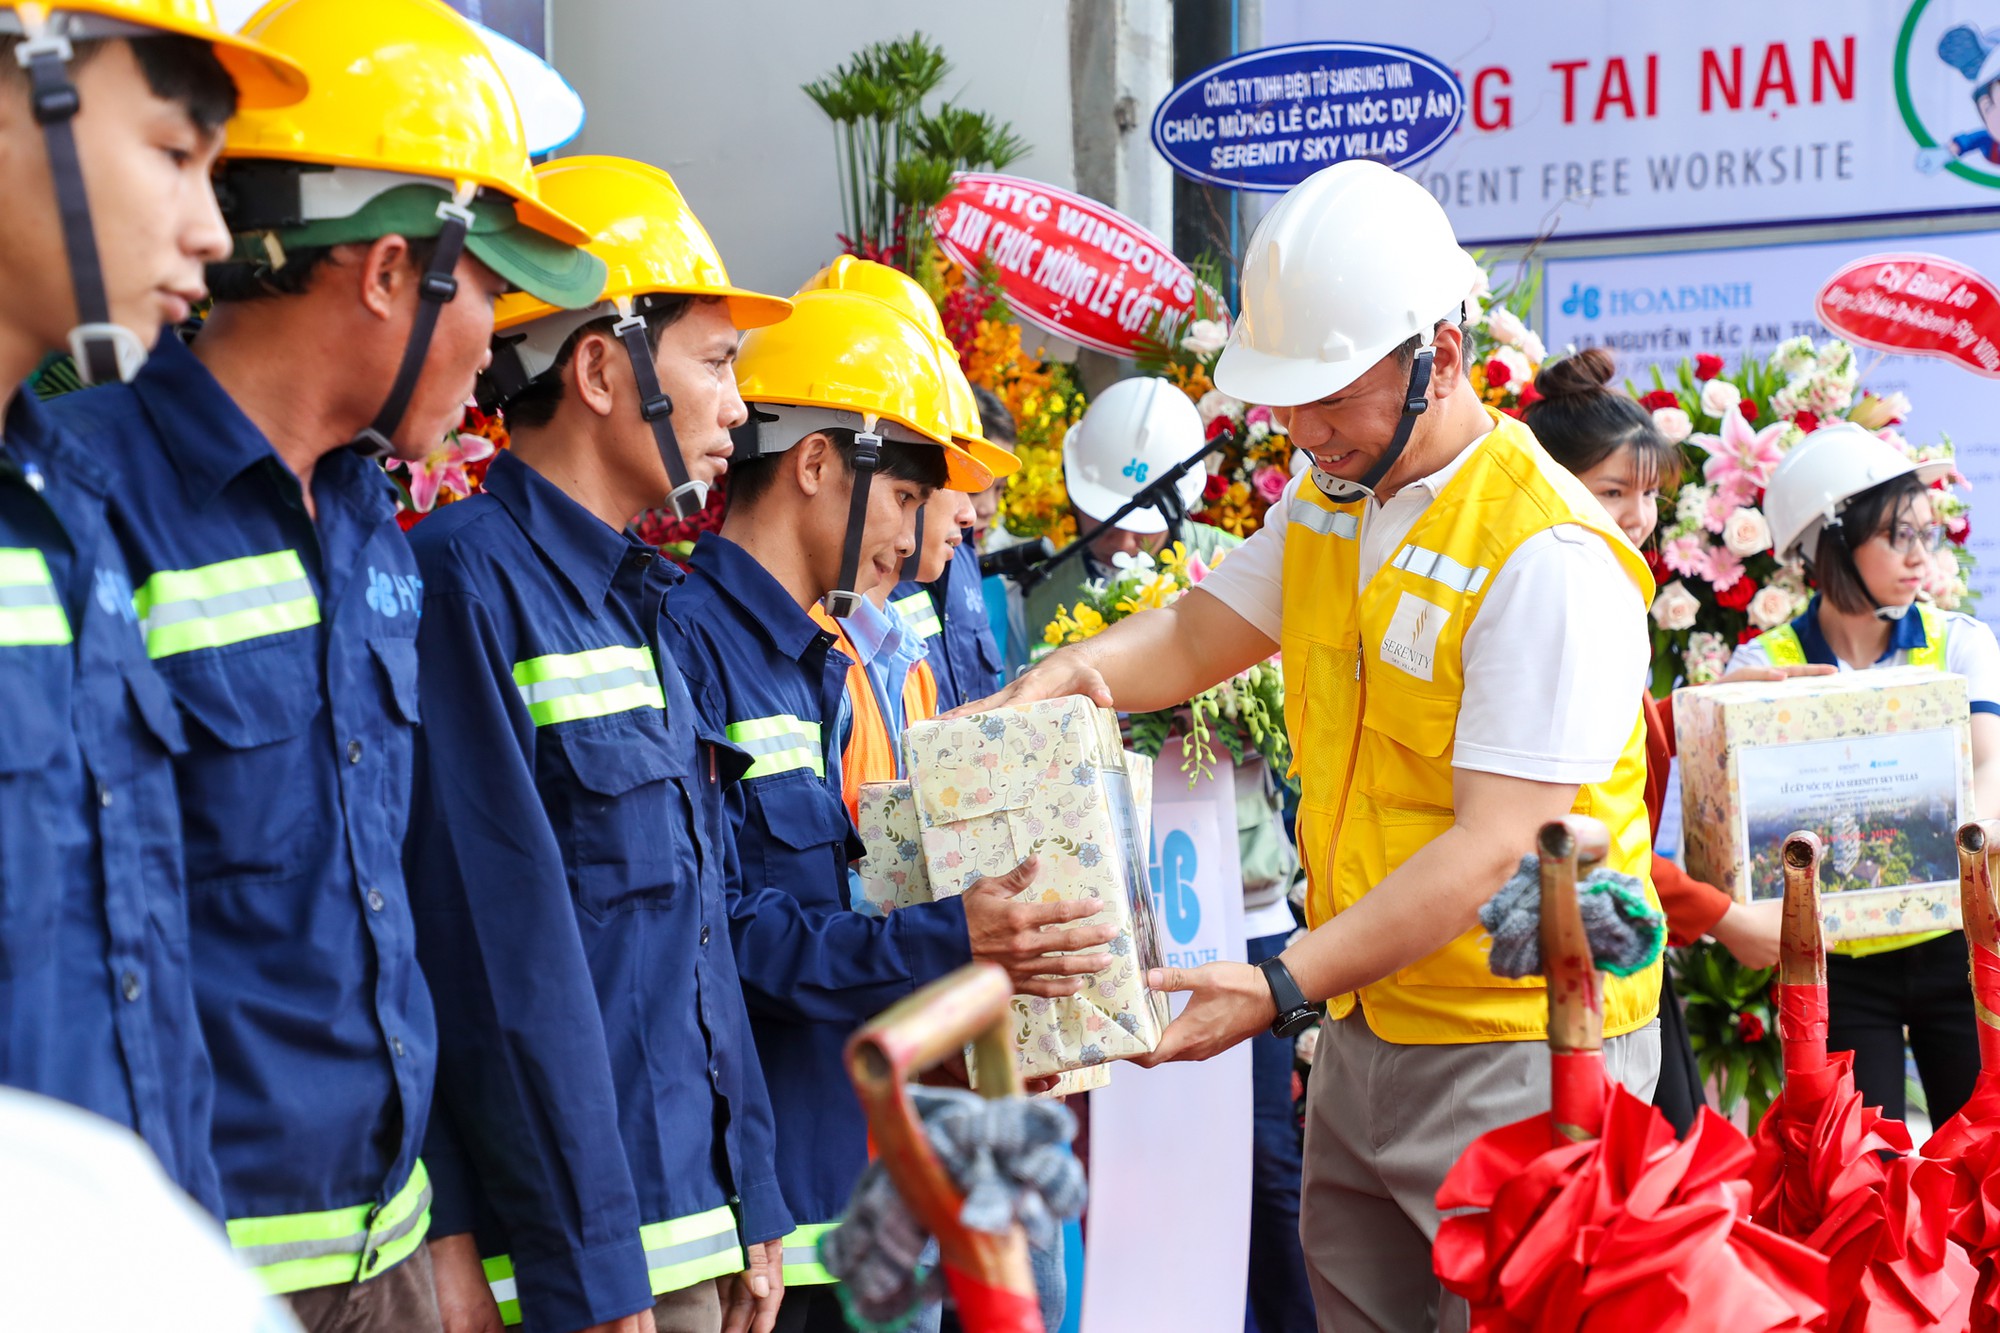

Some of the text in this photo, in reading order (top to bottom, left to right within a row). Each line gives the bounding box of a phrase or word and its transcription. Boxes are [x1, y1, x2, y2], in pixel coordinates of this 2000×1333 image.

[1236, 79, 1253, 104] TY
[1328, 66, 1385, 96] SAMSUNG
[1385, 62, 1414, 88] VINA
[1550, 53, 1659, 125] TAI
[1699, 36, 1856, 121] NẠN
[1162, 113, 1216, 144] CHÚC
[1218, 108, 1276, 139] MỪNG
[1346, 96, 1389, 127] NÓC
[1391, 95, 1422, 127] DỰ
[1424, 89, 1453, 119] ÁN
[1210, 128, 1409, 170] SERENITY SKY VILLAS
[1542, 156, 1630, 200] FREE
[1646, 140, 1855, 193] WORKSITE
[948, 201, 993, 253] XIN
[986, 222, 1042, 278] CHÚC
[1032, 244, 1099, 307] MỪNG
[983, 183, 1196, 304] HTC WINDOWS
[1945, 283, 1979, 310] An
[1751, 322, 1781, 344] AN
[1382, 638, 1432, 669] SERENITY
[1846, 776, 1879, 788] SERENITY
[1880, 774, 1894, 785] SKY
[1895, 772, 1919, 784] VILLAS
